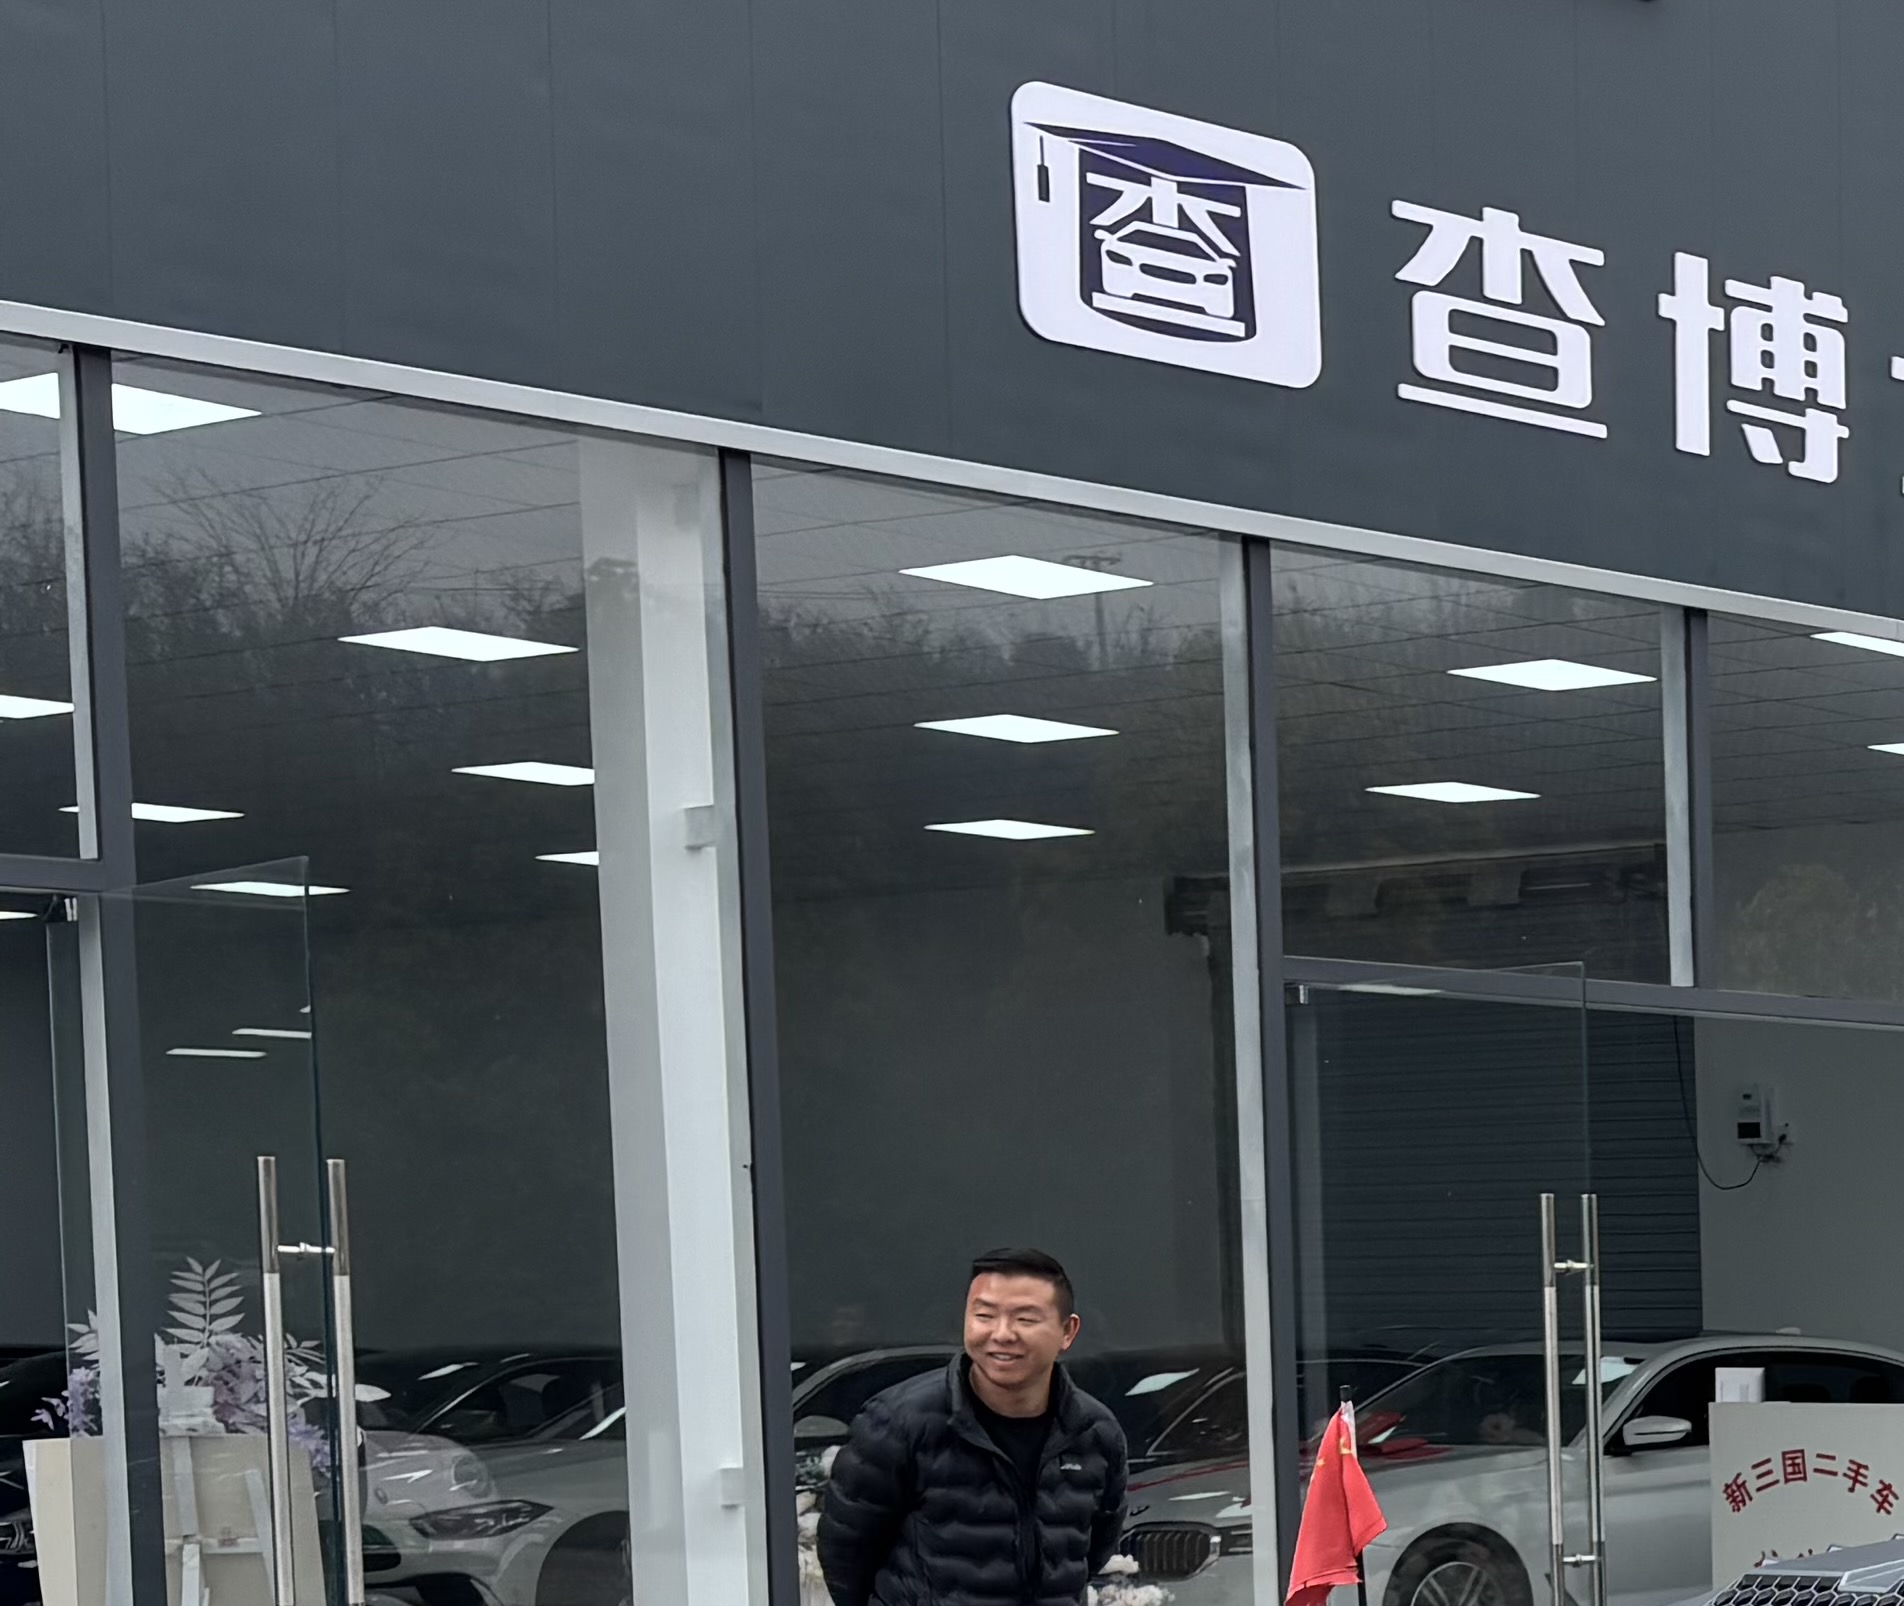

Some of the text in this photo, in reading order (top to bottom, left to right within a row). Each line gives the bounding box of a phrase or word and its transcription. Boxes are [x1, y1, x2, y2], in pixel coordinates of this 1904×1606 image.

[1722, 1448, 1900, 1516] 新三国二手车
